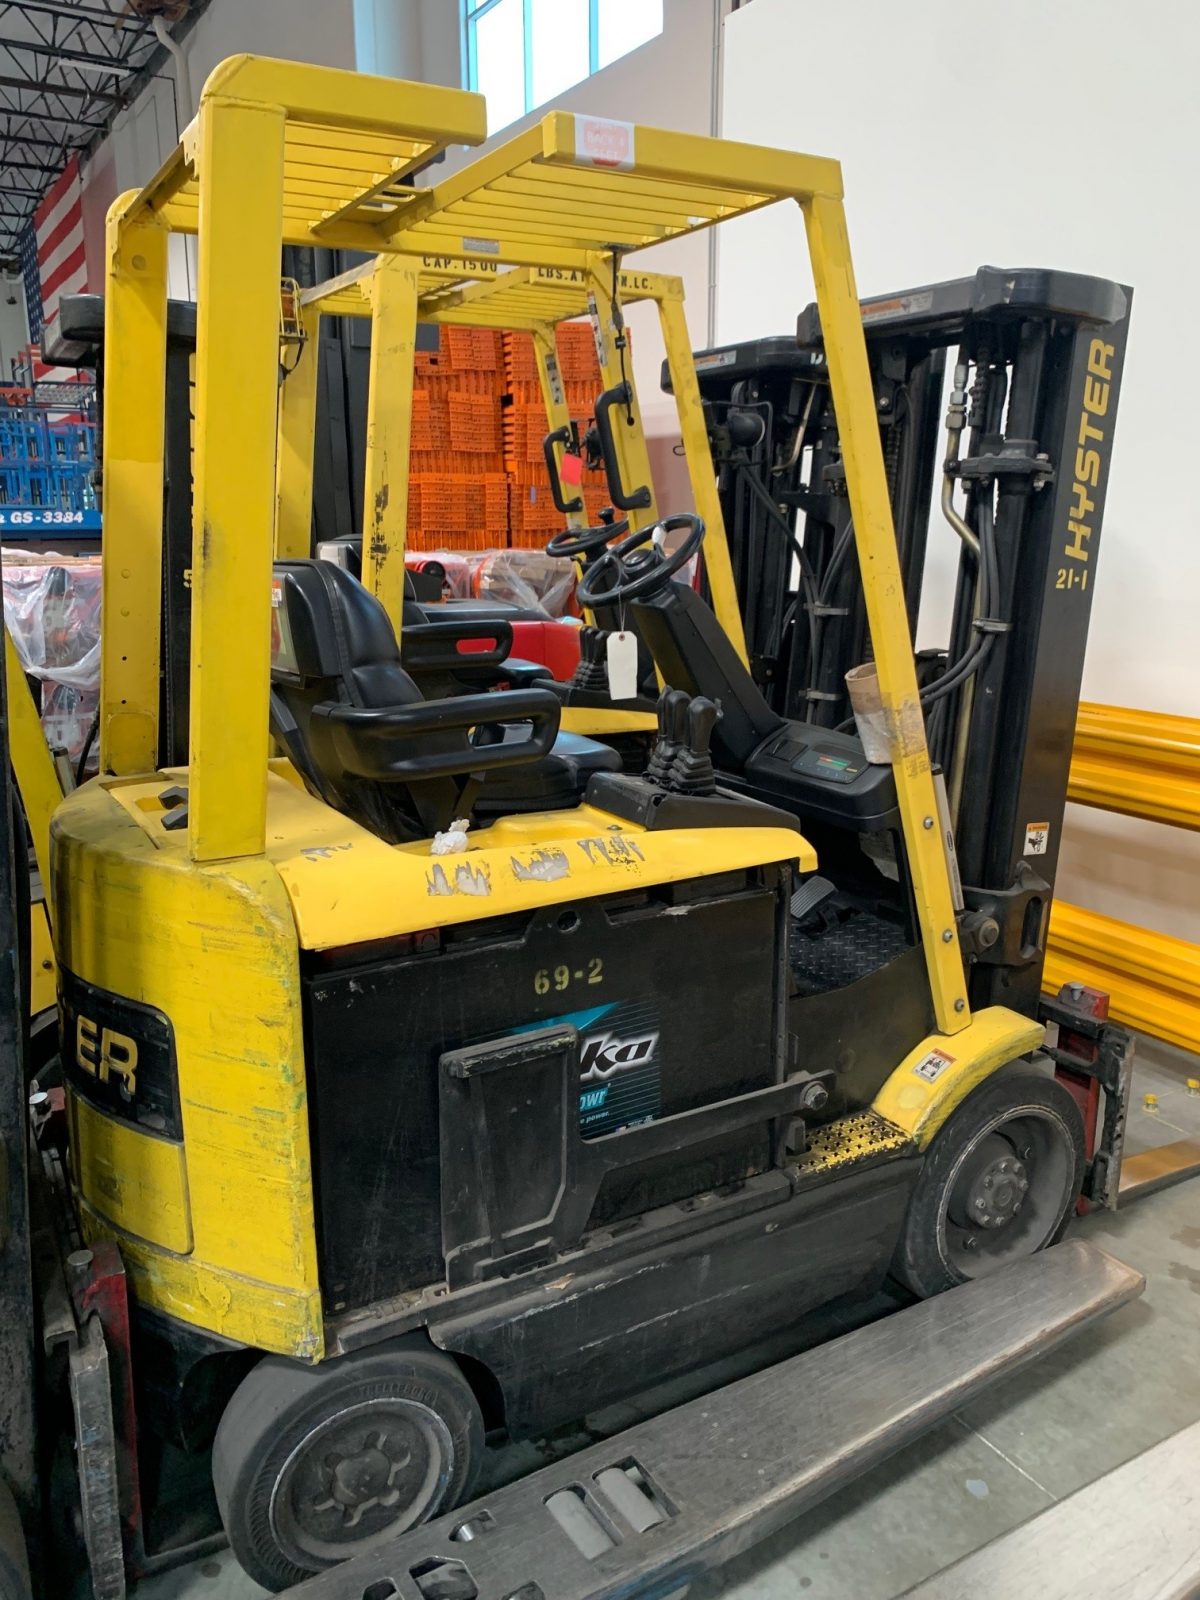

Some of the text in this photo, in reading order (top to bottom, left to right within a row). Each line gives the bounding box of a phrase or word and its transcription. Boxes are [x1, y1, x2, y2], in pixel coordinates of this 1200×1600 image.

[1064, 338, 1115, 562] HYSTER
[534, 958, 603, 995] 69-2
[77, 1014, 138, 1096] ER
